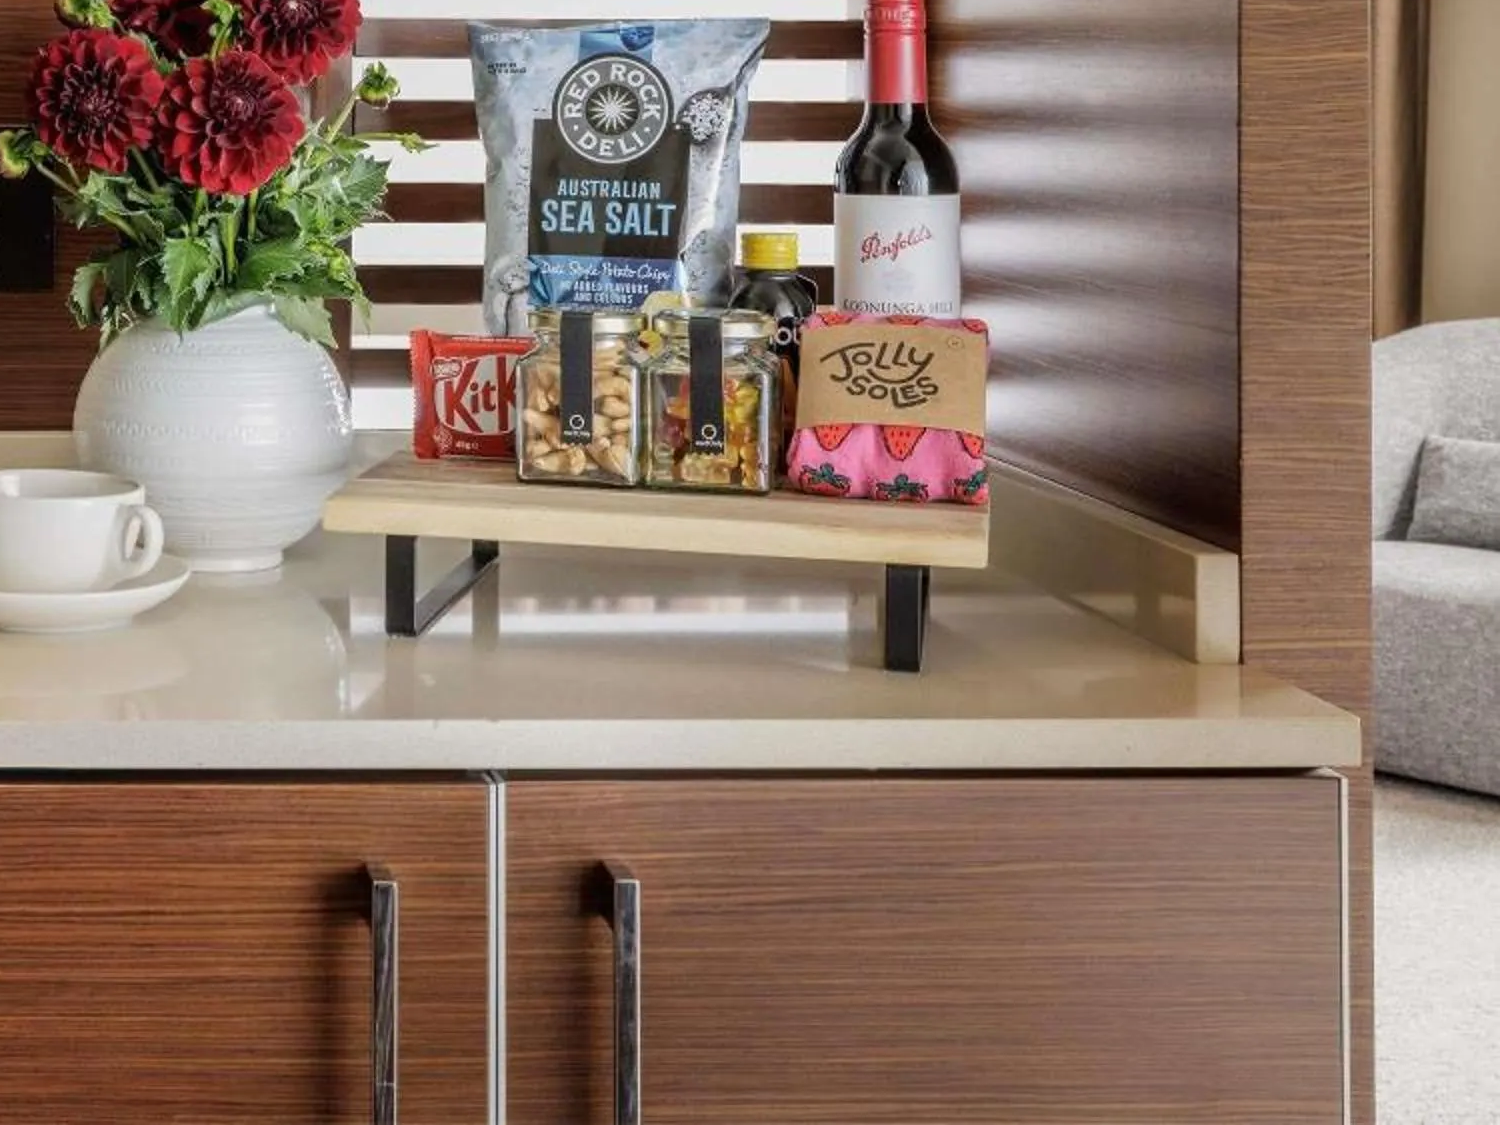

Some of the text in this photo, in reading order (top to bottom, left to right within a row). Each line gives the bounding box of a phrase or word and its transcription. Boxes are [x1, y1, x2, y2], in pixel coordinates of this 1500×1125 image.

[564, 63, 661, 120] RED ROCK
[577, 131, 645, 156] DELI
[557, 178, 661, 199] AUSTRALIAN
[541, 198, 676, 236] SEA SALT
[443, 355, 517, 433] KitK
[846, 375, 938, 409] SOLES
